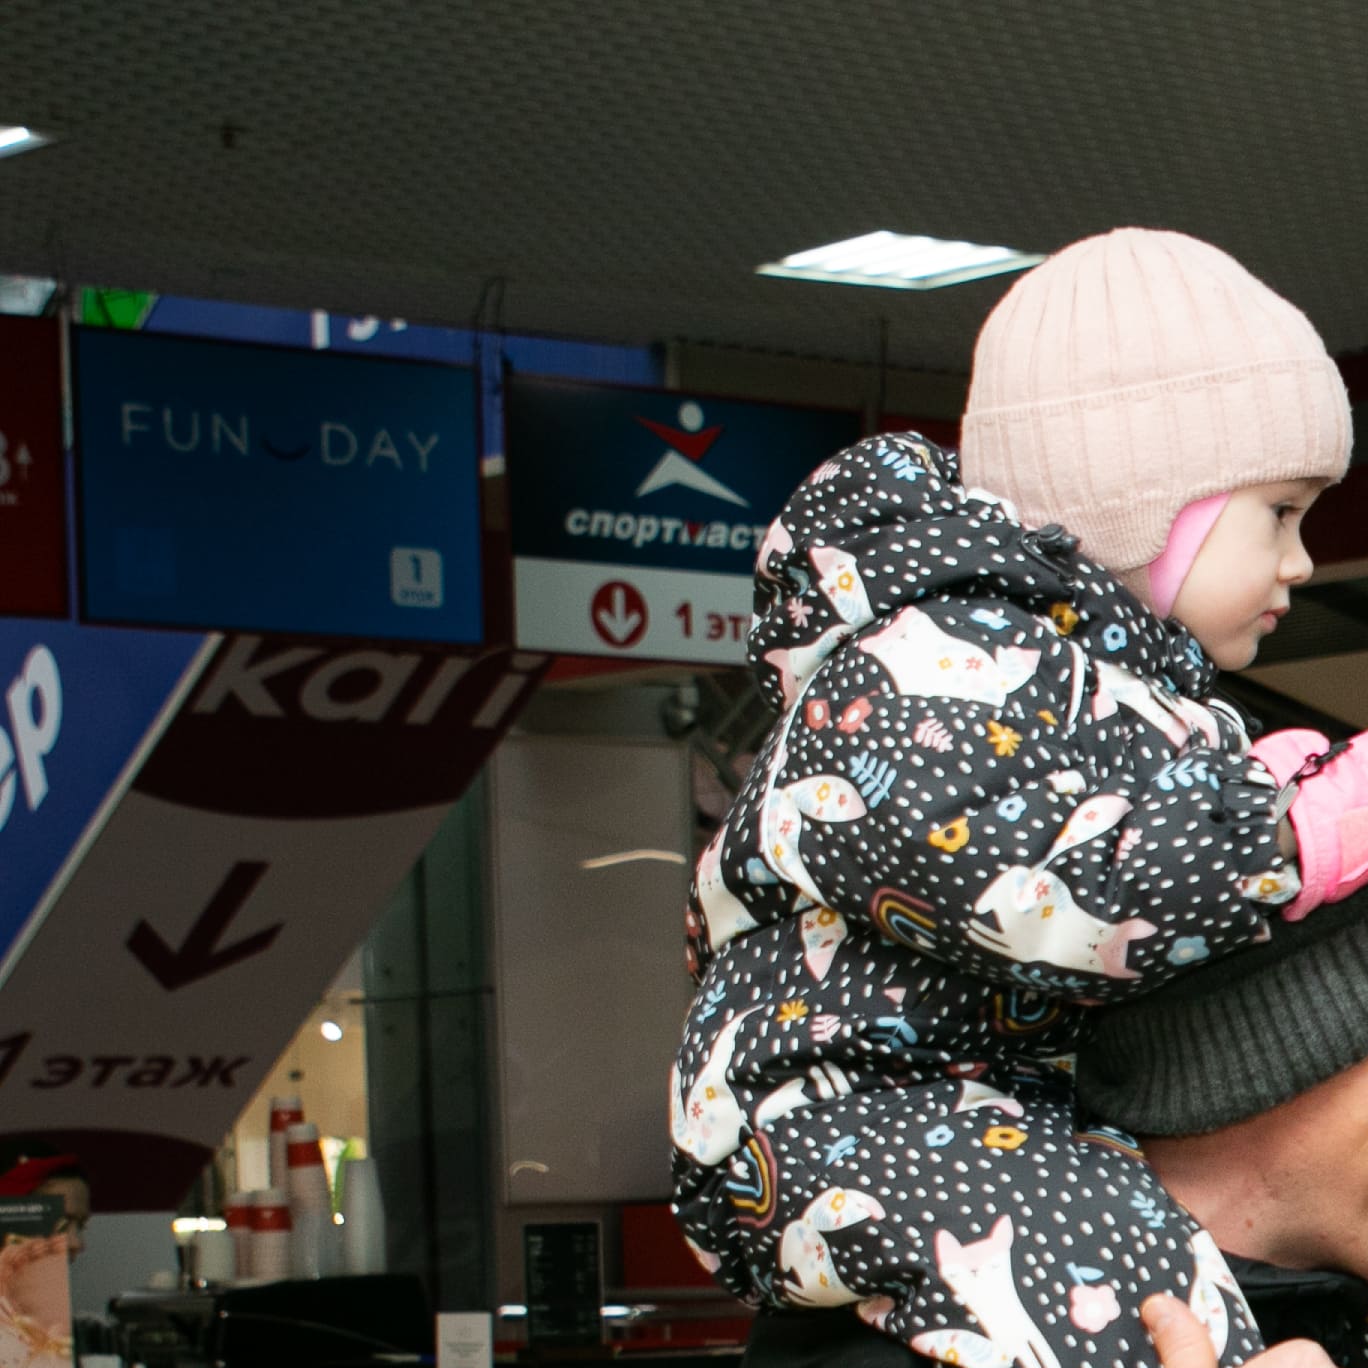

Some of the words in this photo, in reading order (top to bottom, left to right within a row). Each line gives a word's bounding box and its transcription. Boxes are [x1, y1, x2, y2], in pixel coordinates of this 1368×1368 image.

[121, 401, 250, 456] FUN
[319, 421, 441, 473] DAY
[674, 601, 694, 639] 1
[706, 613, 752, 641] эт
[191, 634, 551, 730] kari
[31, 1056, 247, 1088] этаж
